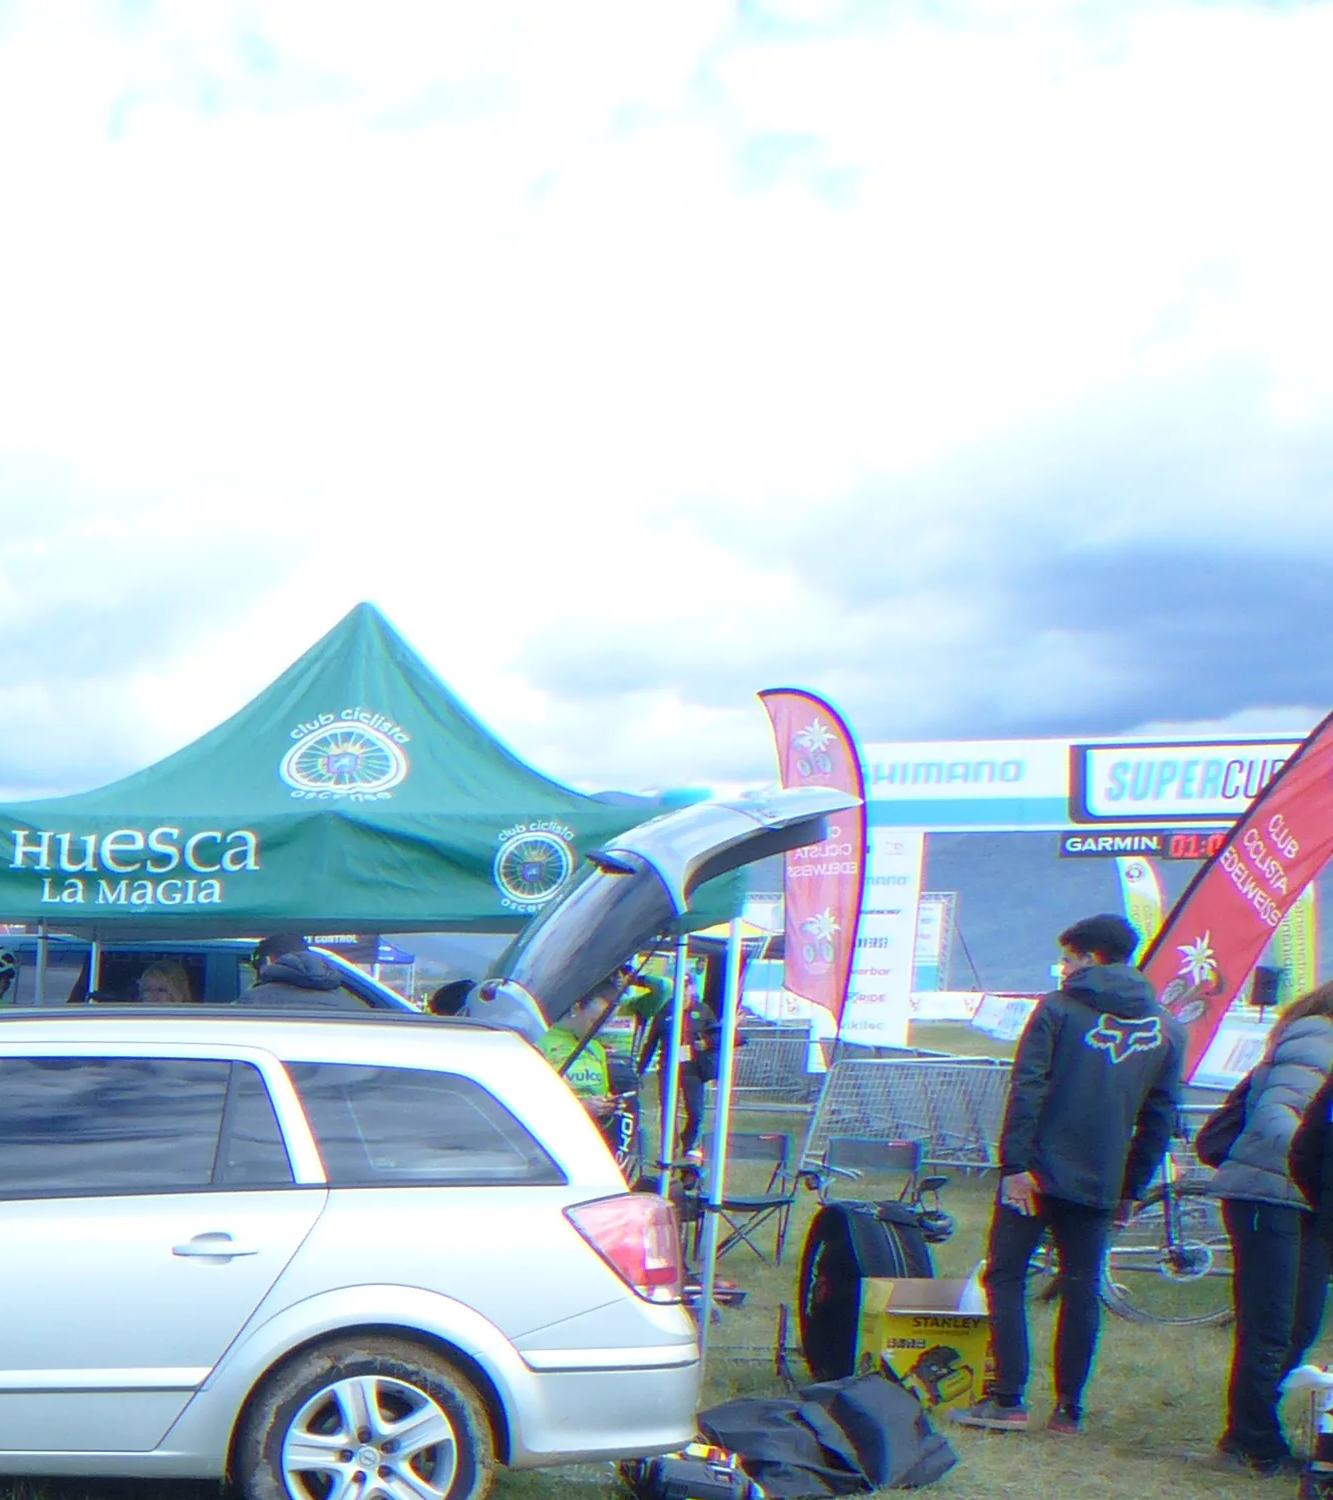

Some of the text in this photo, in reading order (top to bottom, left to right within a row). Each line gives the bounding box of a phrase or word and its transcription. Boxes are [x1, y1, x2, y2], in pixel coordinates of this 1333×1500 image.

[290, 706, 410, 744] club ciclista
[1065, 836, 1160, 853] GARMIN
[1268, 813, 1300, 859] CLUB
[1244, 828, 1288, 895] CICLISTA
[501, 898, 545, 912] osce
[1220, 846, 1283, 927] EDELWEISS
[913, 1316, 981, 1329] STANLEY
